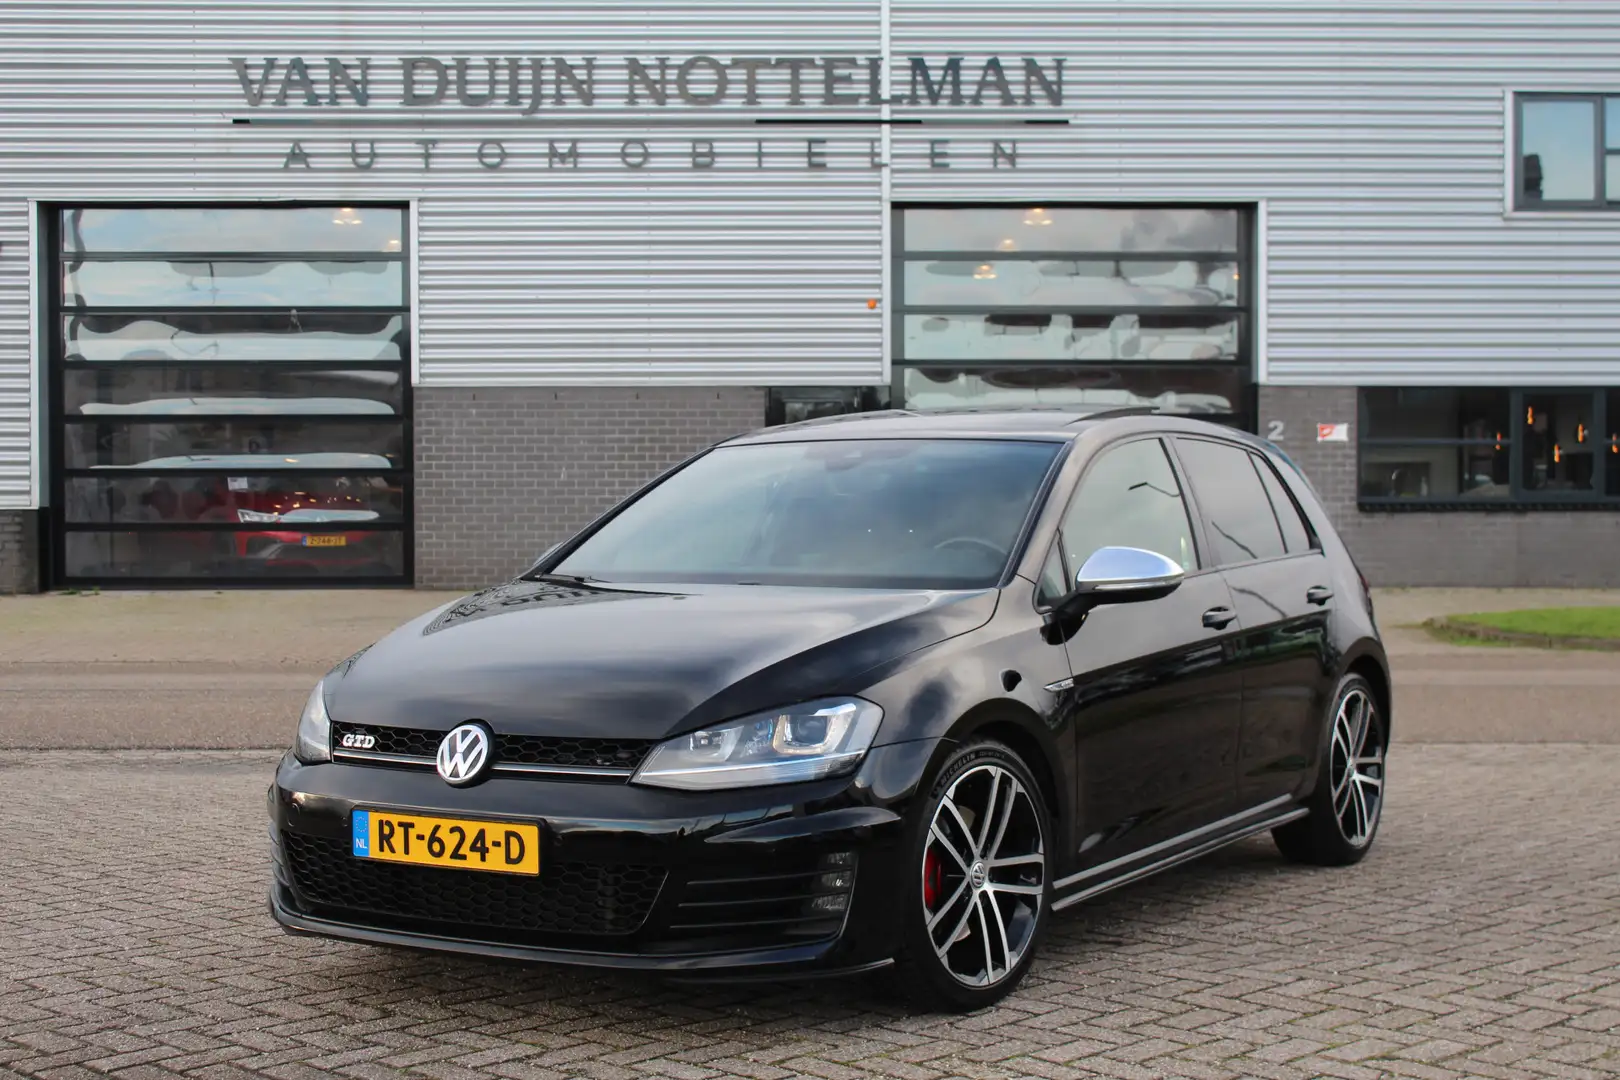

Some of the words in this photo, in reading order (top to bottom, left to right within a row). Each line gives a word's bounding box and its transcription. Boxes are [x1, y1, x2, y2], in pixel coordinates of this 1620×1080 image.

[228, 57, 371, 107] VAN
[398, 57, 597, 115] DUIJN
[623, 56, 1067, 106] NOTTELMAN
[284, 140, 1017, 170] AUTOMOBIELEN
[1267, 420, 1285, 441] 2
[342, 733, 375, 749] GTD
[355, 837, 368, 849] NL
[377, 818, 525, 865] RT-624-D
